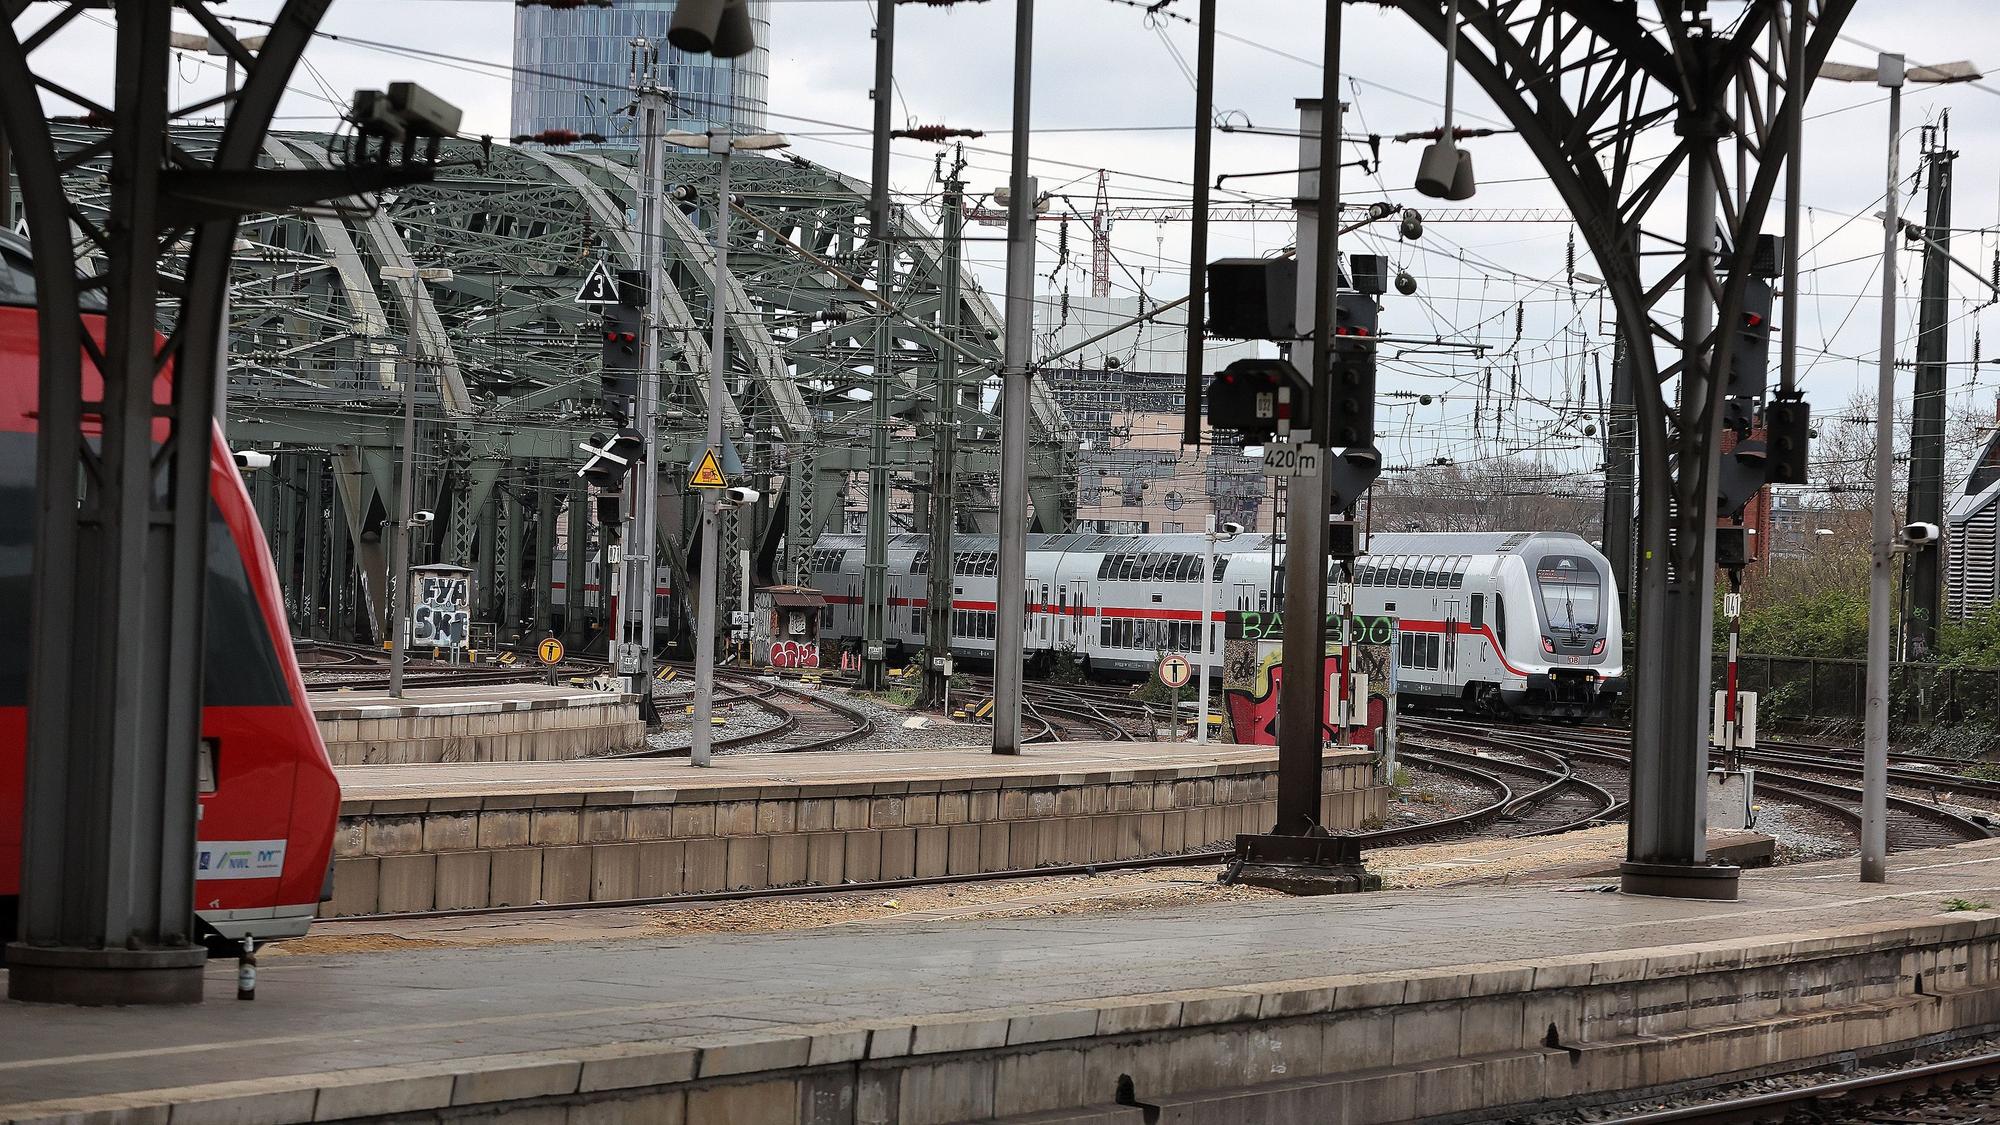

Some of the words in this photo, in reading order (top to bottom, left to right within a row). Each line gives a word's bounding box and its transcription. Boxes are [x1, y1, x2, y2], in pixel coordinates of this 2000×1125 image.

[593, 274, 604, 298] 3
[1264, 450, 1295, 468] 420
[1300, 456, 1315, 469] m
[1338, 584, 1351, 603] 051
[1725, 595, 1739, 615] 041
[1480, 641, 1487, 662] IC
